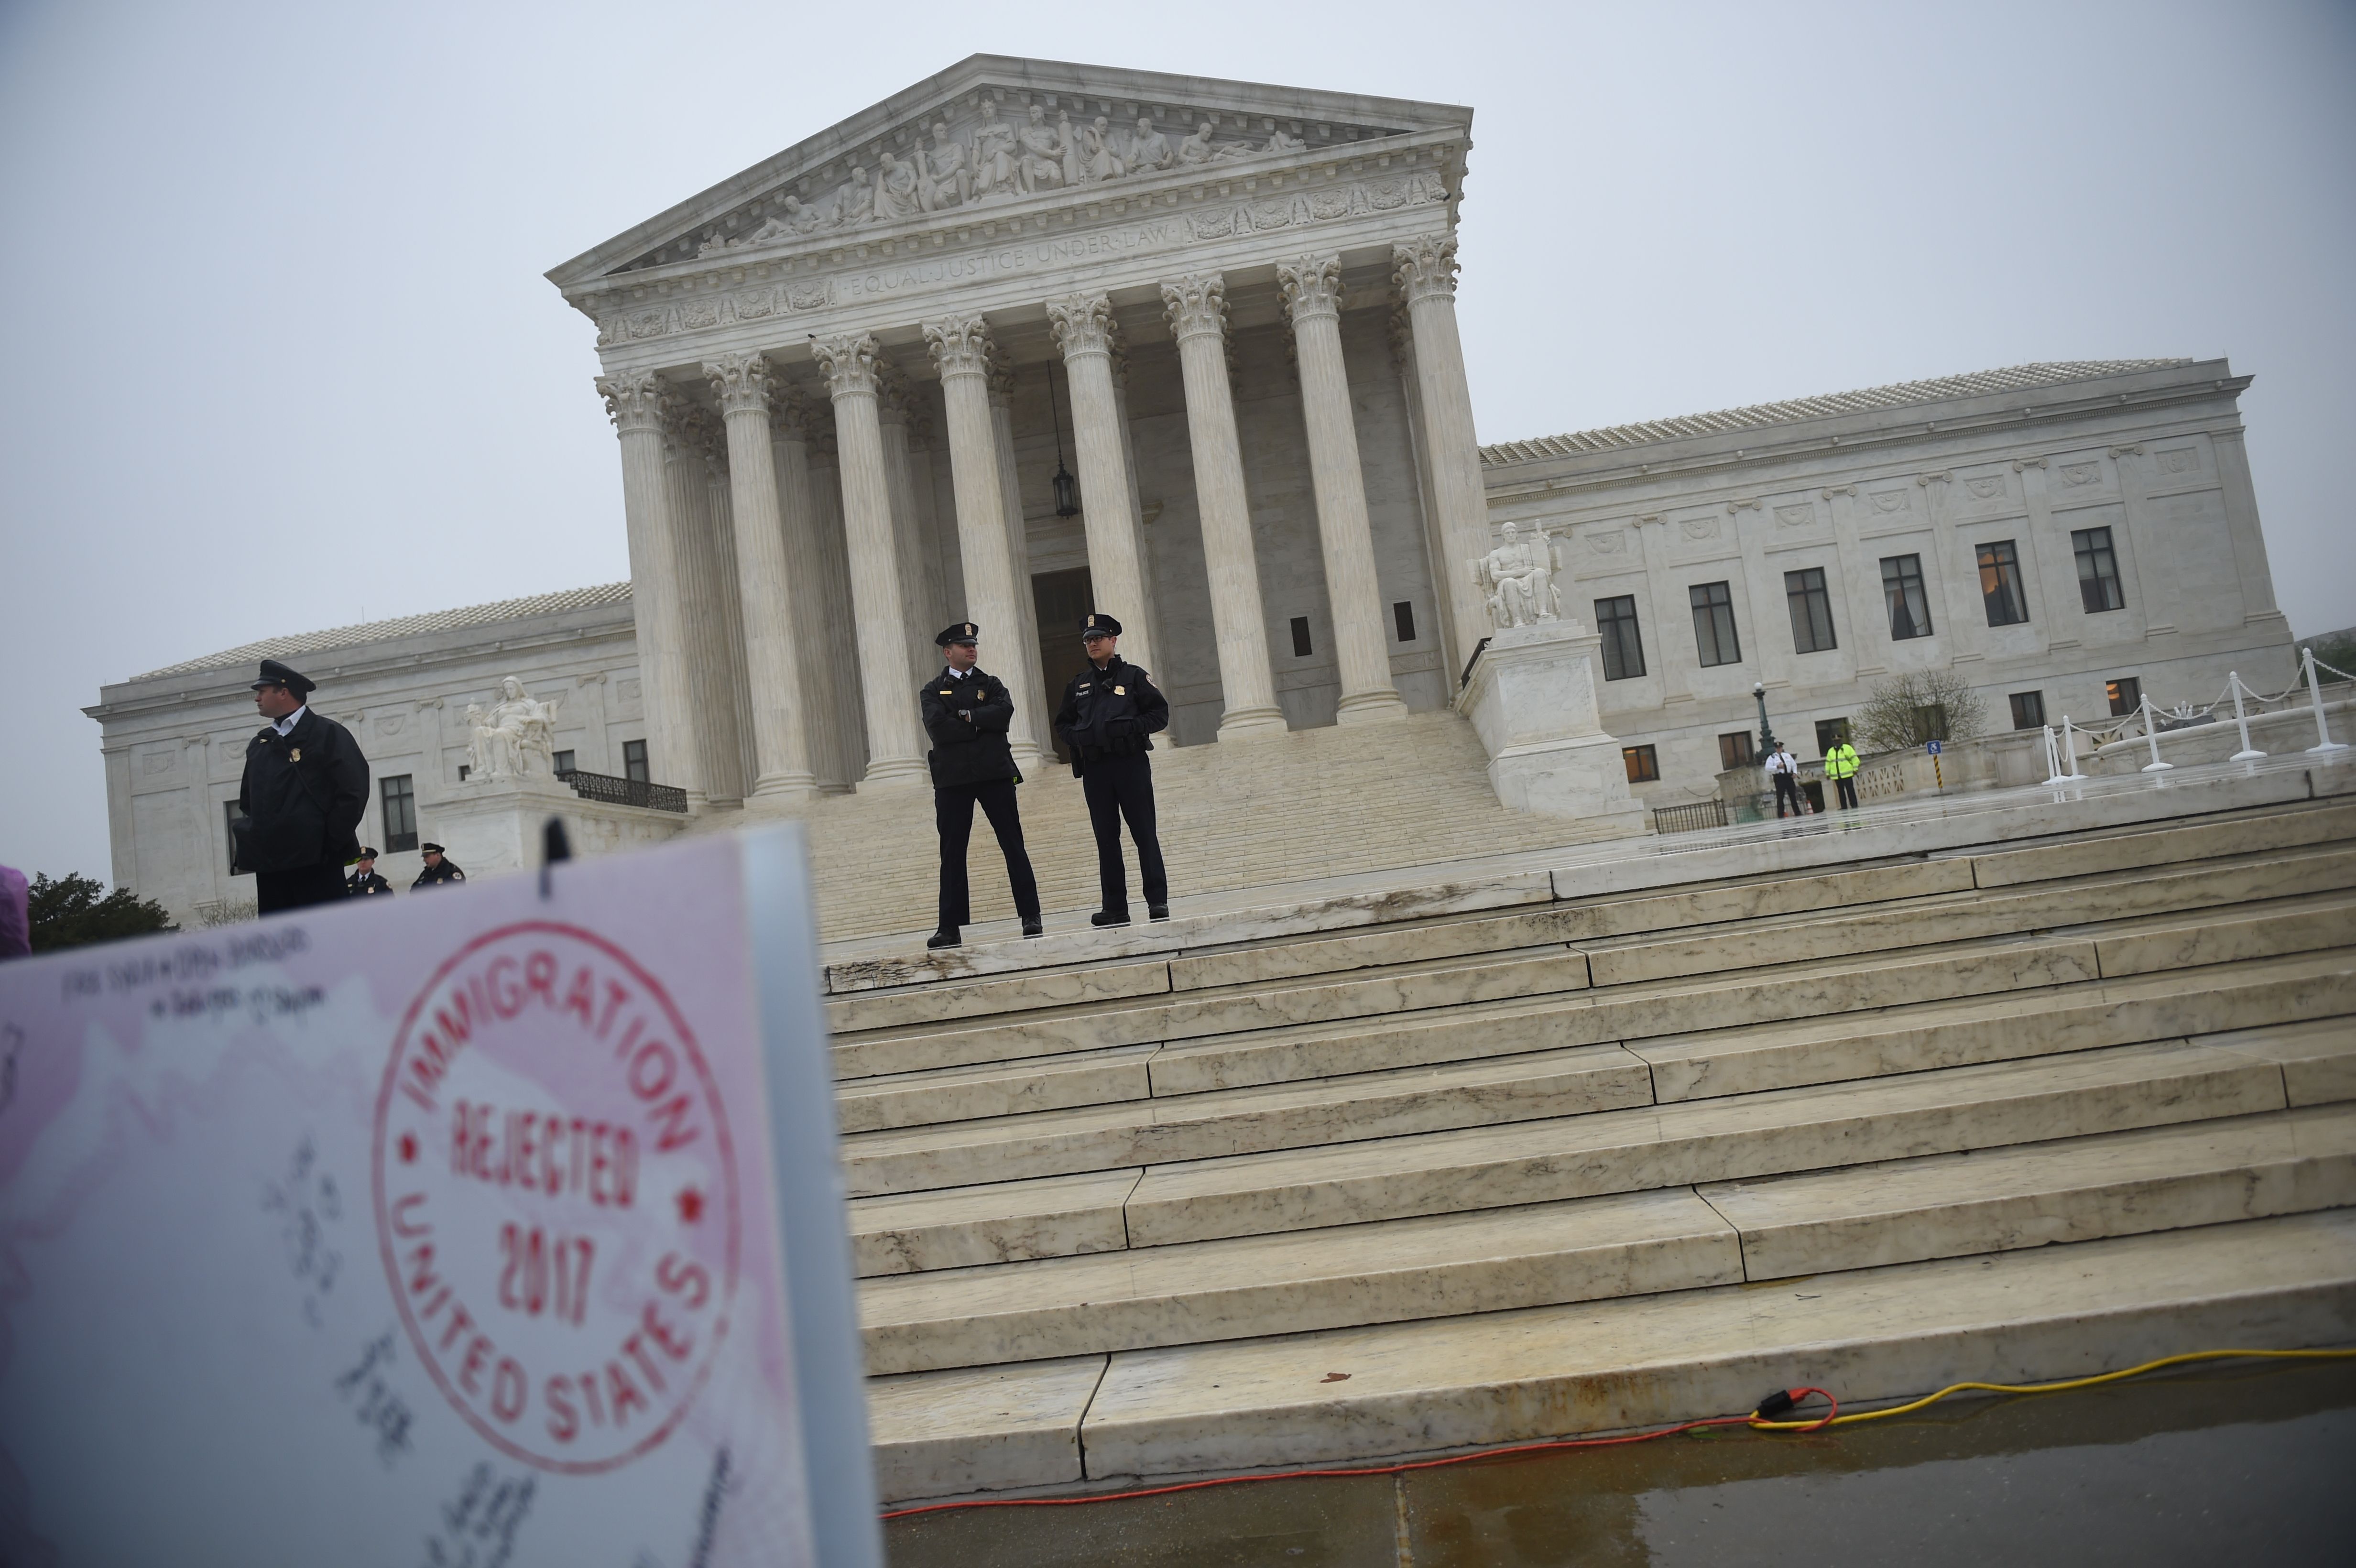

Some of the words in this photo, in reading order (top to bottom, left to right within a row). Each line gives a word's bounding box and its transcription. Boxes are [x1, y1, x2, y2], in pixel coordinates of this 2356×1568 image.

[851, 268, 929, 295] EQUAL
[934, 250, 1025, 281] JUSTICE
[1036, 235, 1117, 262] UNDER
[1123, 224, 1168, 248] LAW
[399, 949, 700, 1155] IMMIGRATION
[450, 1098, 641, 1209] REJECTED
[390, 1192, 530, 1425] UNITED
[545, 1250, 711, 1444] STATES
[498, 1220, 596, 1328] 2017
